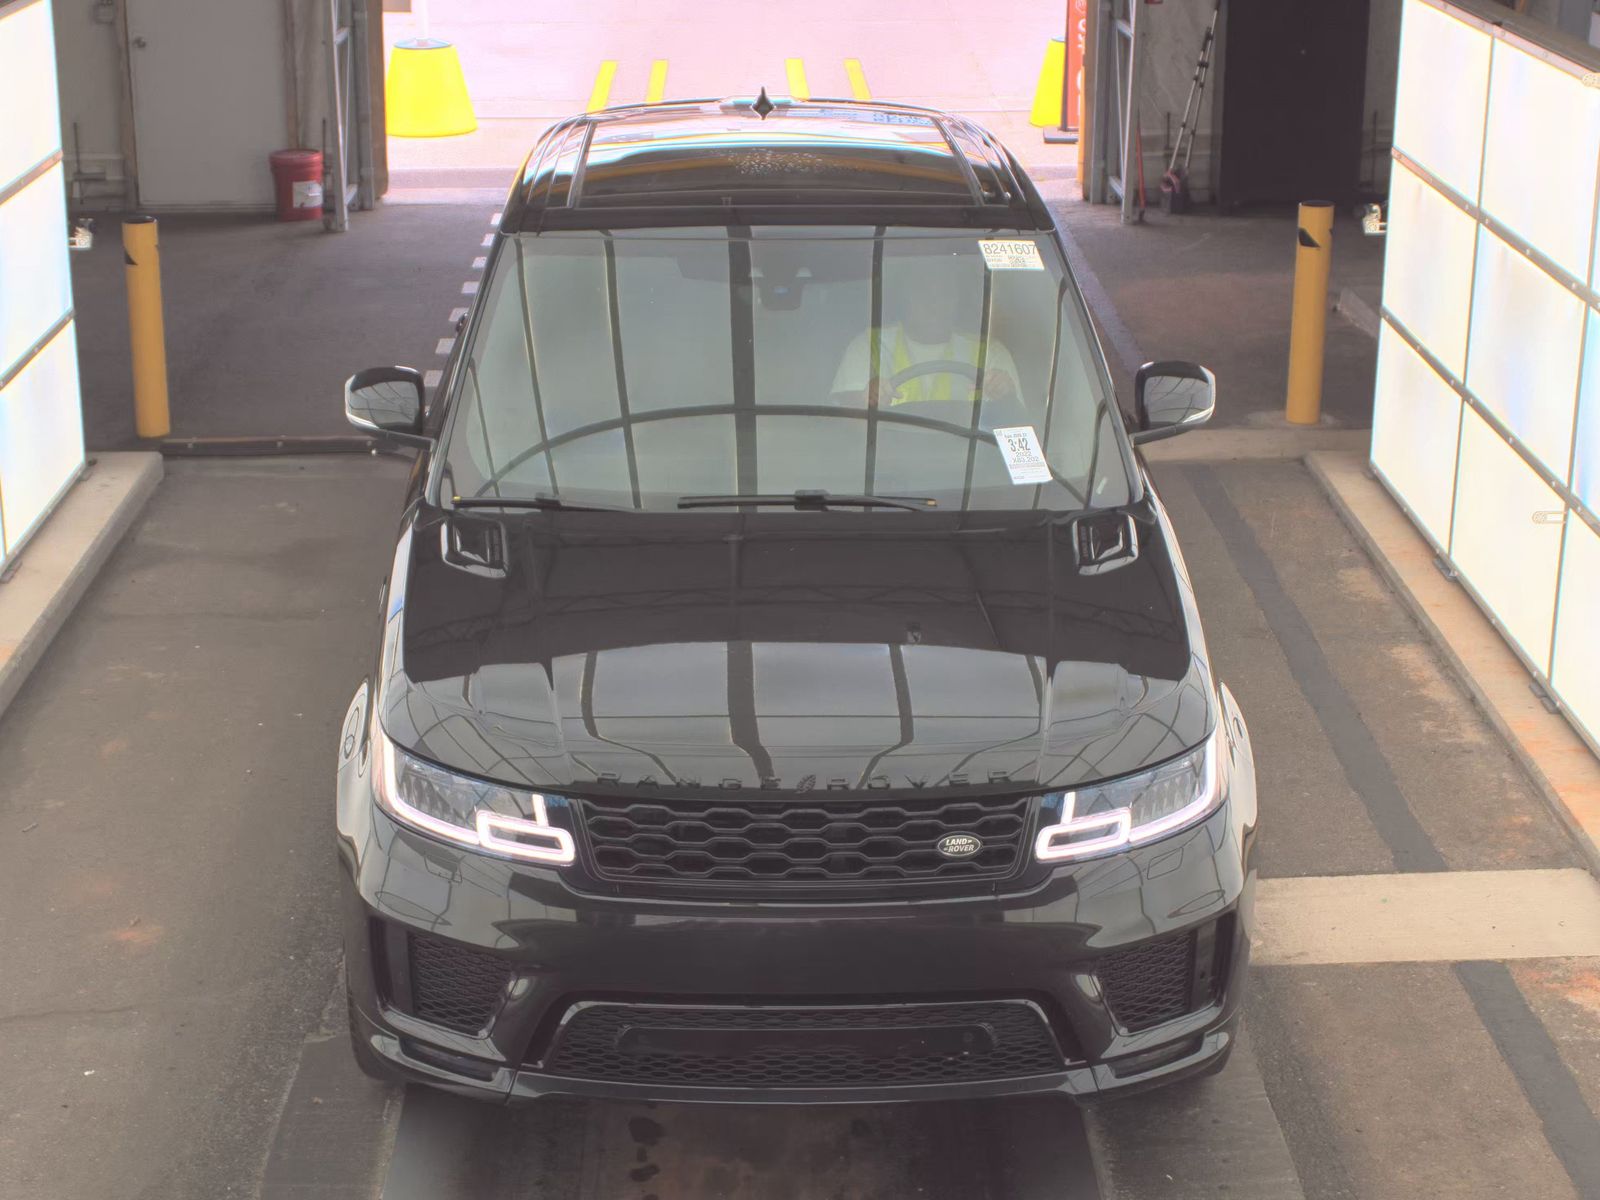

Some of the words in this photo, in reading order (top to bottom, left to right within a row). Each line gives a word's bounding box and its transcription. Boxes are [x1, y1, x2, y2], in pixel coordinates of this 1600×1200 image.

[983, 243, 1036, 255] 8241607
[597, 772, 782, 791] RANGE
[826, 770, 1010, 790] ROVER
[946, 838, 968, 846] LAND
[948, 844, 975, 852] ROVER
